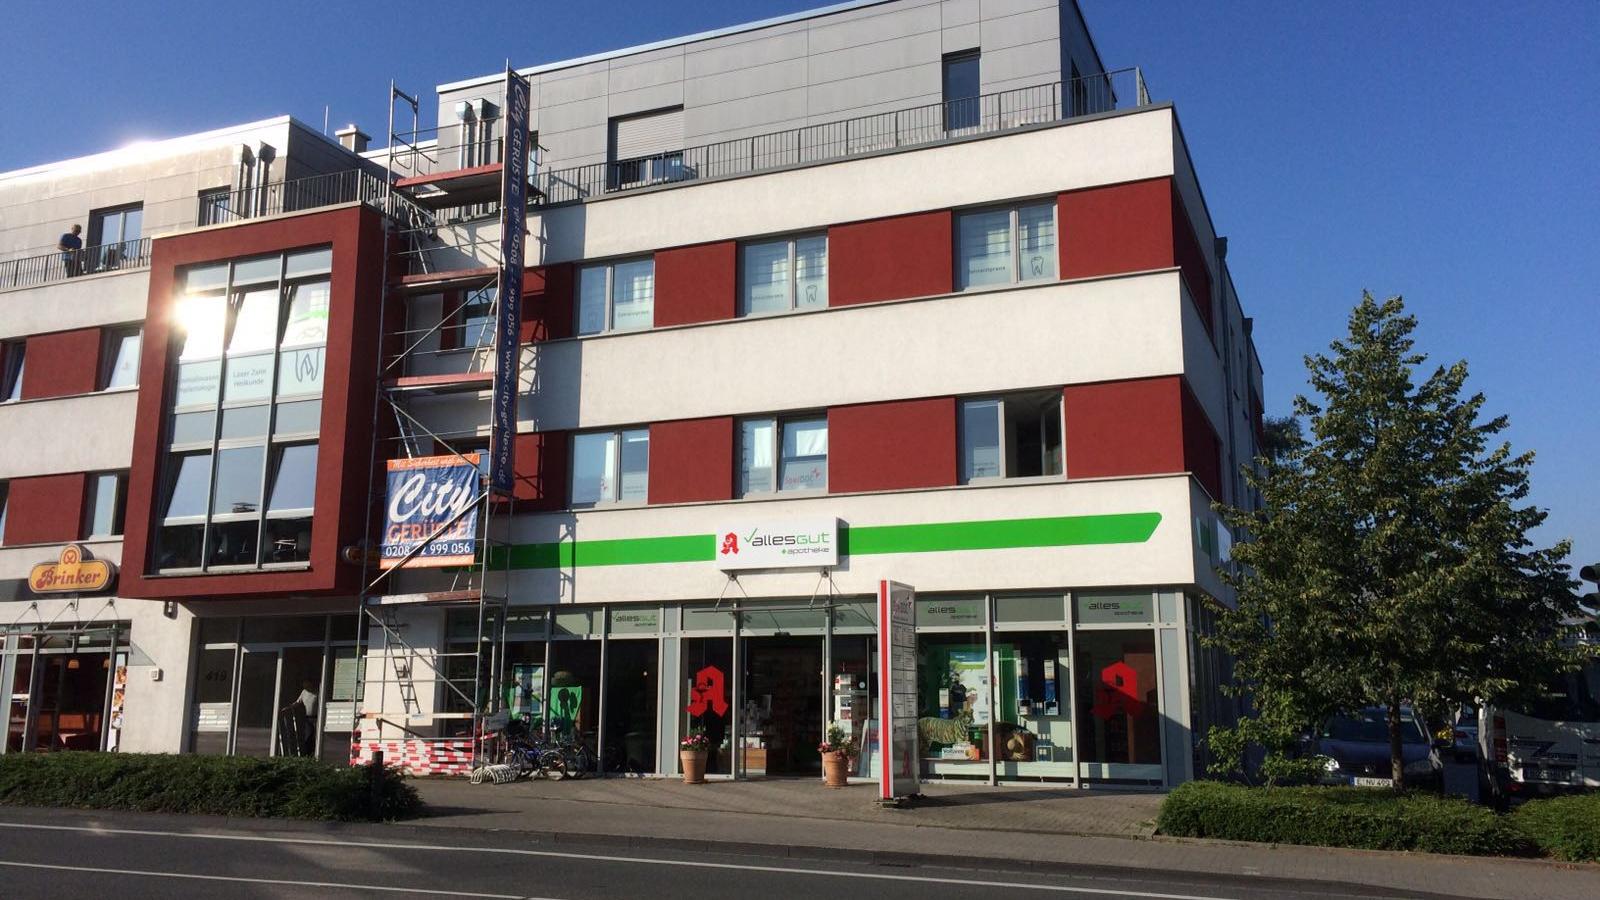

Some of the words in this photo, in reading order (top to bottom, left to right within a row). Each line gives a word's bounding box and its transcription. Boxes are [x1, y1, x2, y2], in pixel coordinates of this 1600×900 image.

[509, 84, 527, 127] City
[510, 233, 520, 265] 0208
[507, 313, 515, 336] 056
[388, 473, 472, 523] City
[387, 519, 469, 544] GERÜE
[385, 546, 410, 557] 0208
[429, 544, 449, 554] 999
[451, 542, 470, 554] 056
[787, 546, 830, 555] apotheke
[36, 567, 101, 589] Brinker
